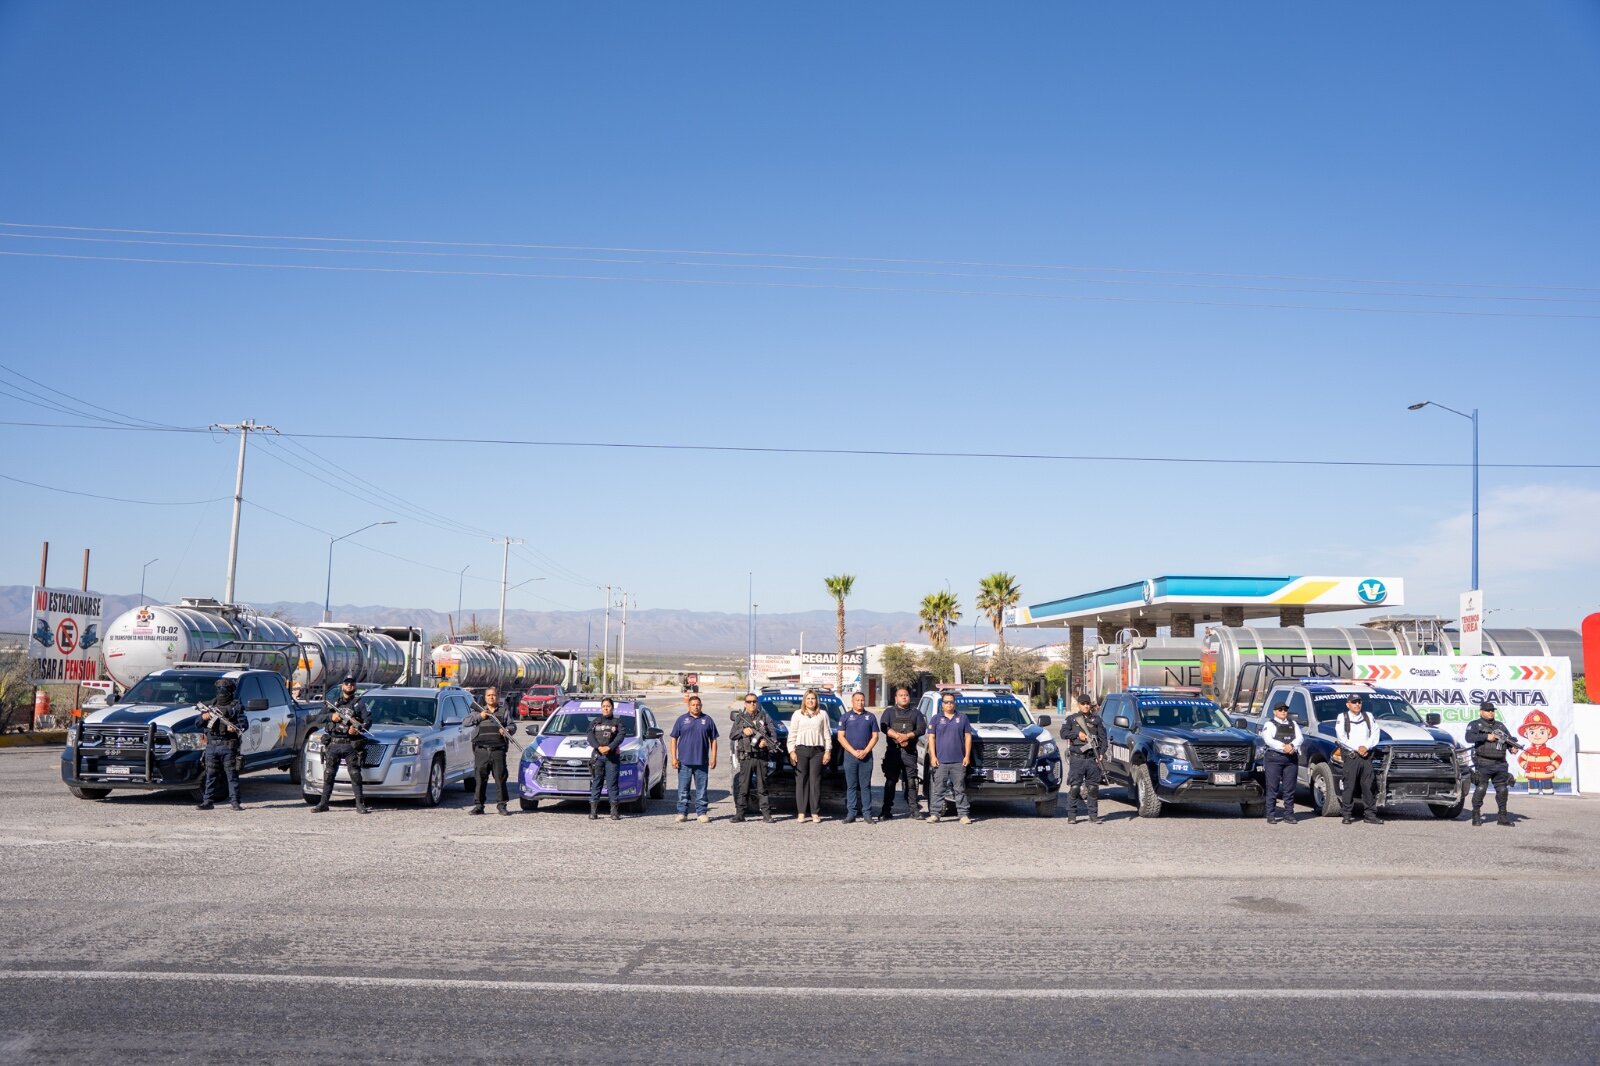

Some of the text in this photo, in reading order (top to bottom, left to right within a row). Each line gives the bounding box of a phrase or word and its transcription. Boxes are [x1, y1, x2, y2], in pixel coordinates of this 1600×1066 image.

[36, 591, 101, 616] NO ESTACIONARSE
[1462, 615, 1479, 623] TENEMOS
[157, 626, 179, 634] TQ-02
[1463, 622, 1478, 633] UREA
[803, 653, 863, 664] REGADRAS
[38, 656, 96, 680] SAR A PENSIÓN
[1396, 688, 1549, 706] MANA SANTA
[105, 736, 140, 745] RAM
